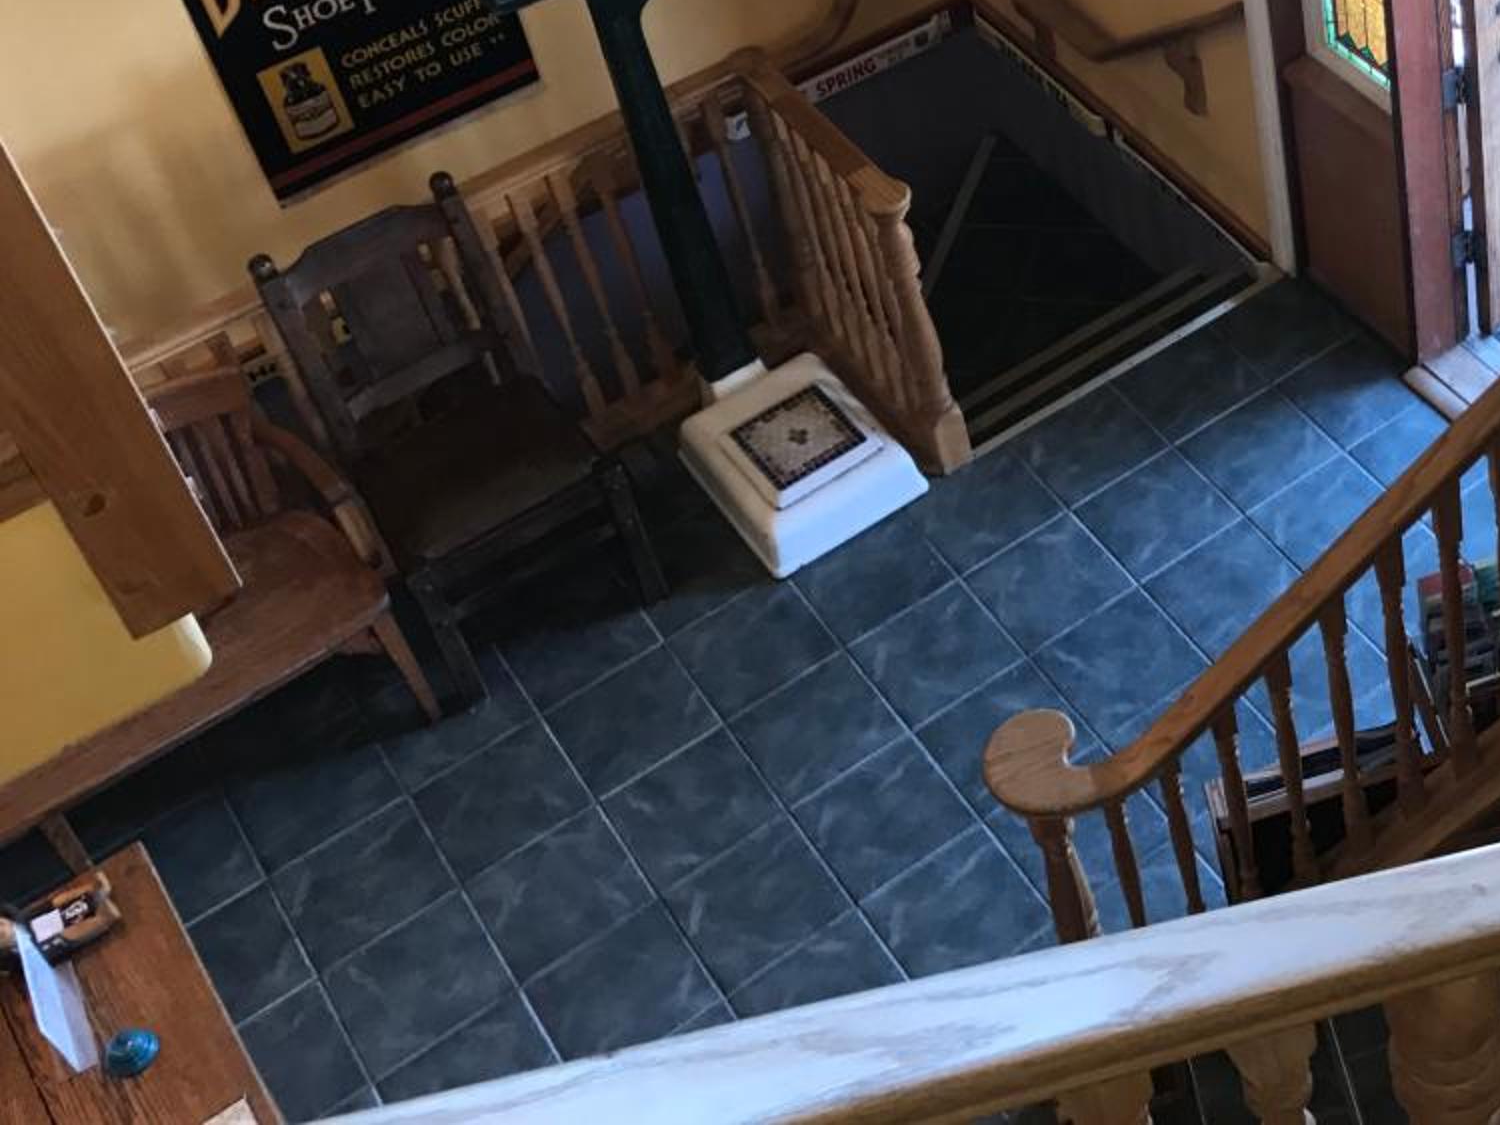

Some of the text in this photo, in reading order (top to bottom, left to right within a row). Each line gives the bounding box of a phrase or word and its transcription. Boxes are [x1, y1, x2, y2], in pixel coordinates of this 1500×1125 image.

[340, 21, 430, 69] CONCEALS
[348, 41, 435, 90] RESTORES
[357, 44, 483, 109] EASY TO USE
[815, 58, 878, 97] SPRING
